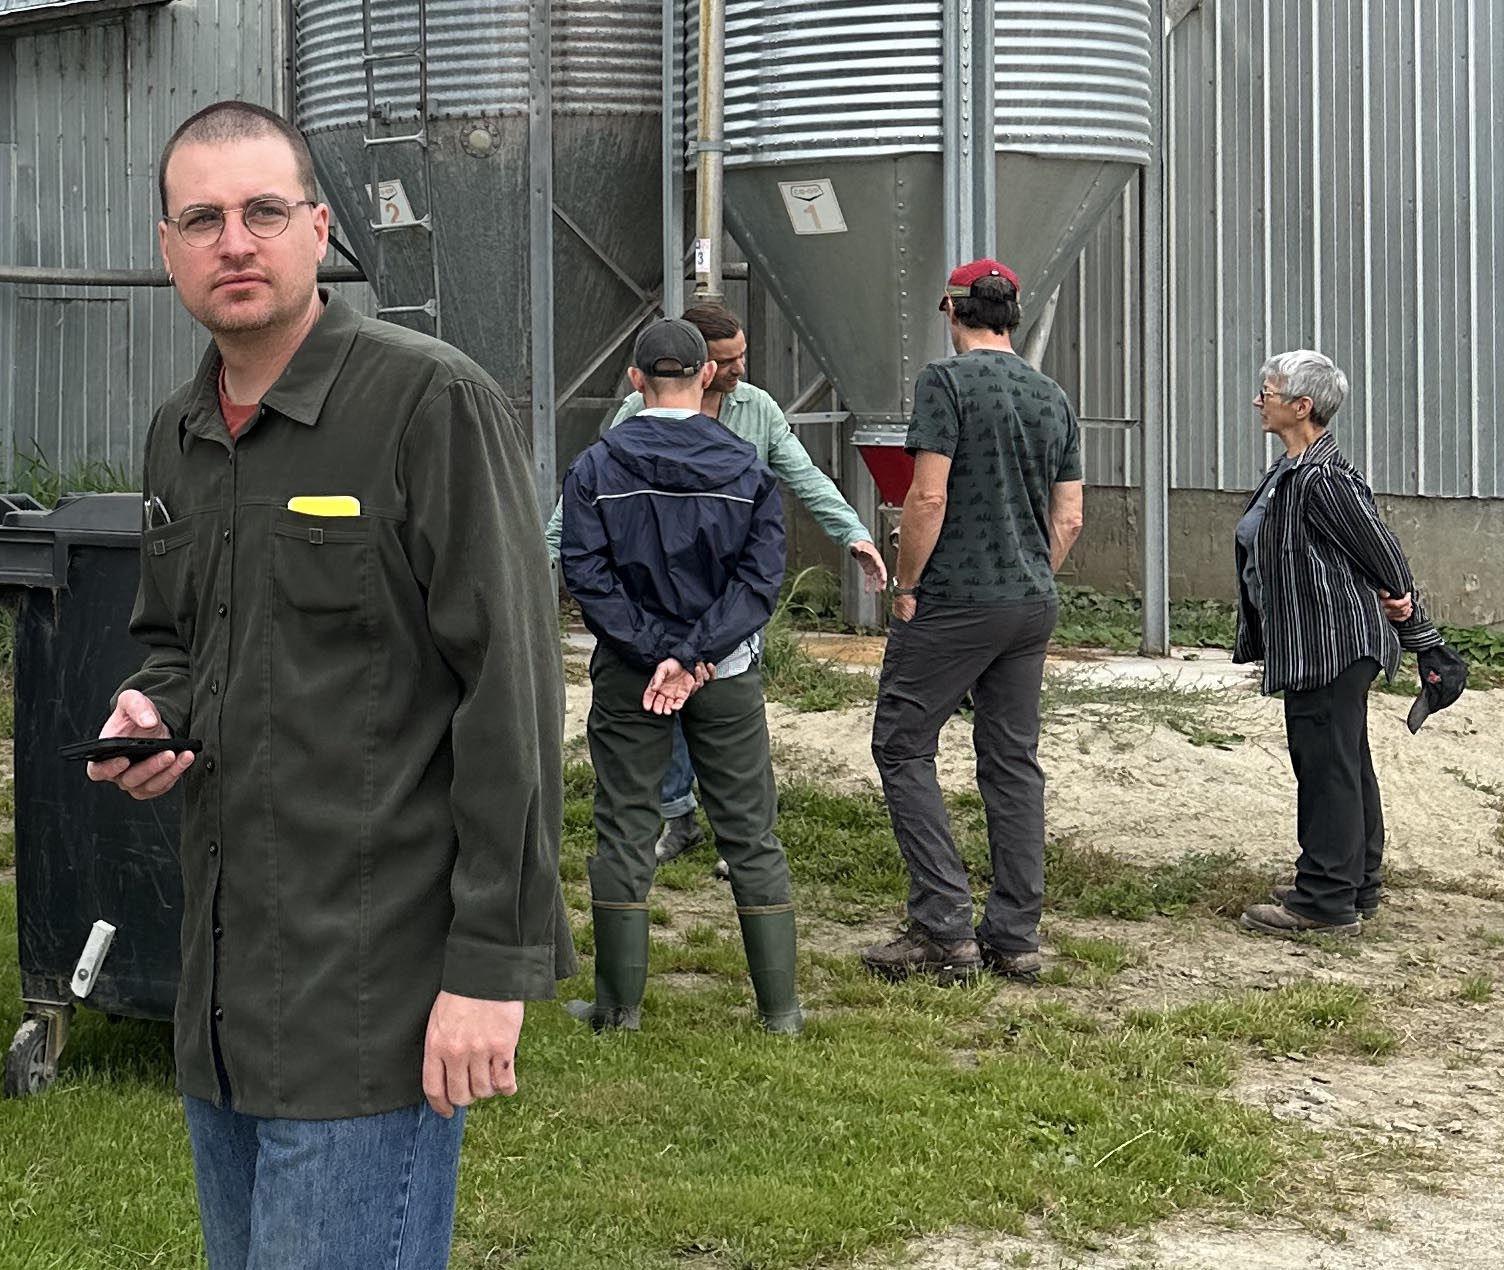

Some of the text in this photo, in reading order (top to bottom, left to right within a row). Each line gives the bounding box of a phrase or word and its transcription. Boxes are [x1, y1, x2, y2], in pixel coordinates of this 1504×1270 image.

[385, 202, 405, 224] 2
[803, 204, 822, 230] 1
[697, 251, 704, 265] 3
